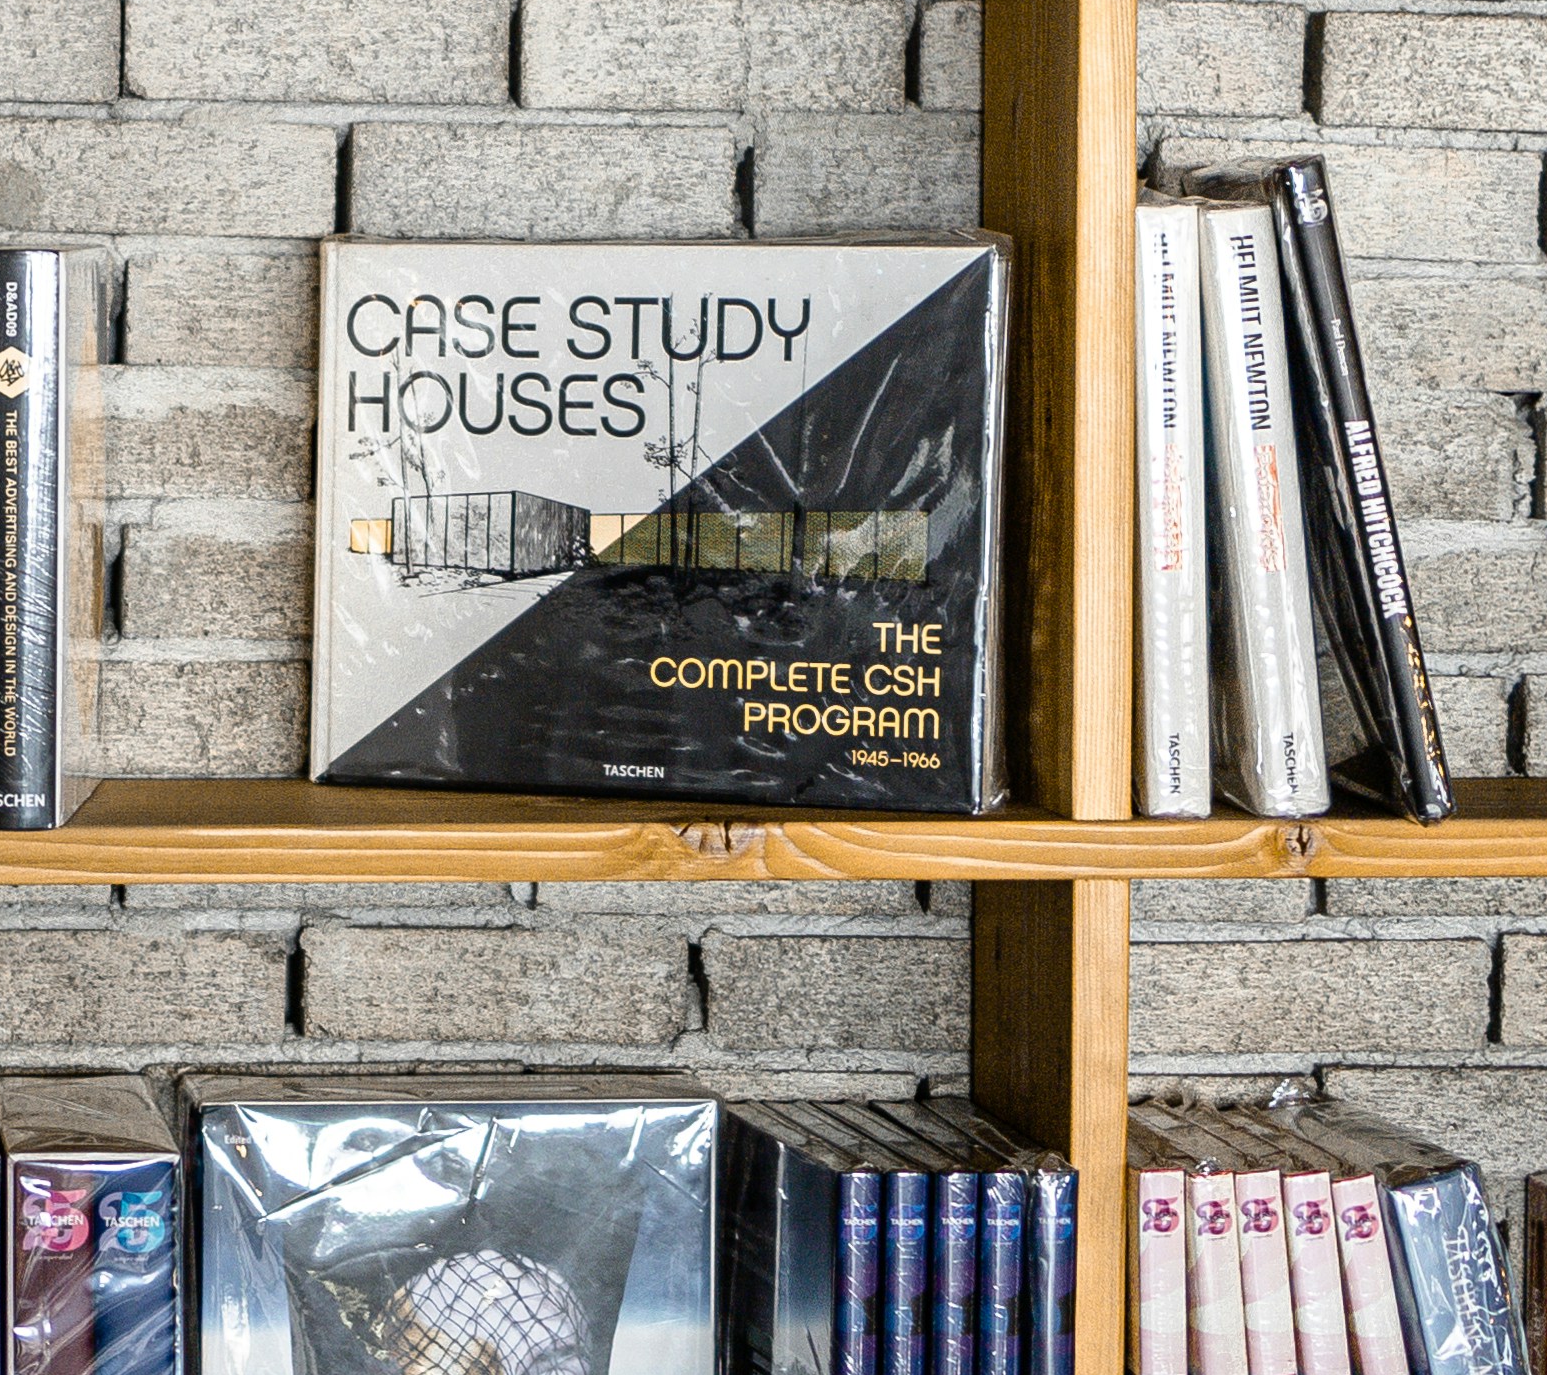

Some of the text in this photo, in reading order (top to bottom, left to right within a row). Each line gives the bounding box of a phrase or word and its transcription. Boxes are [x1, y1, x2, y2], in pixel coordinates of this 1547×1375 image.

[346, 294, 811, 362] CASE STUDY
[347, 371, 646, 437] HOUSES
[872, 622, 942, 655] THE
[649, 656, 941, 697] COMPLETE CSH
[743, 702, 940, 739] PROGRAM
